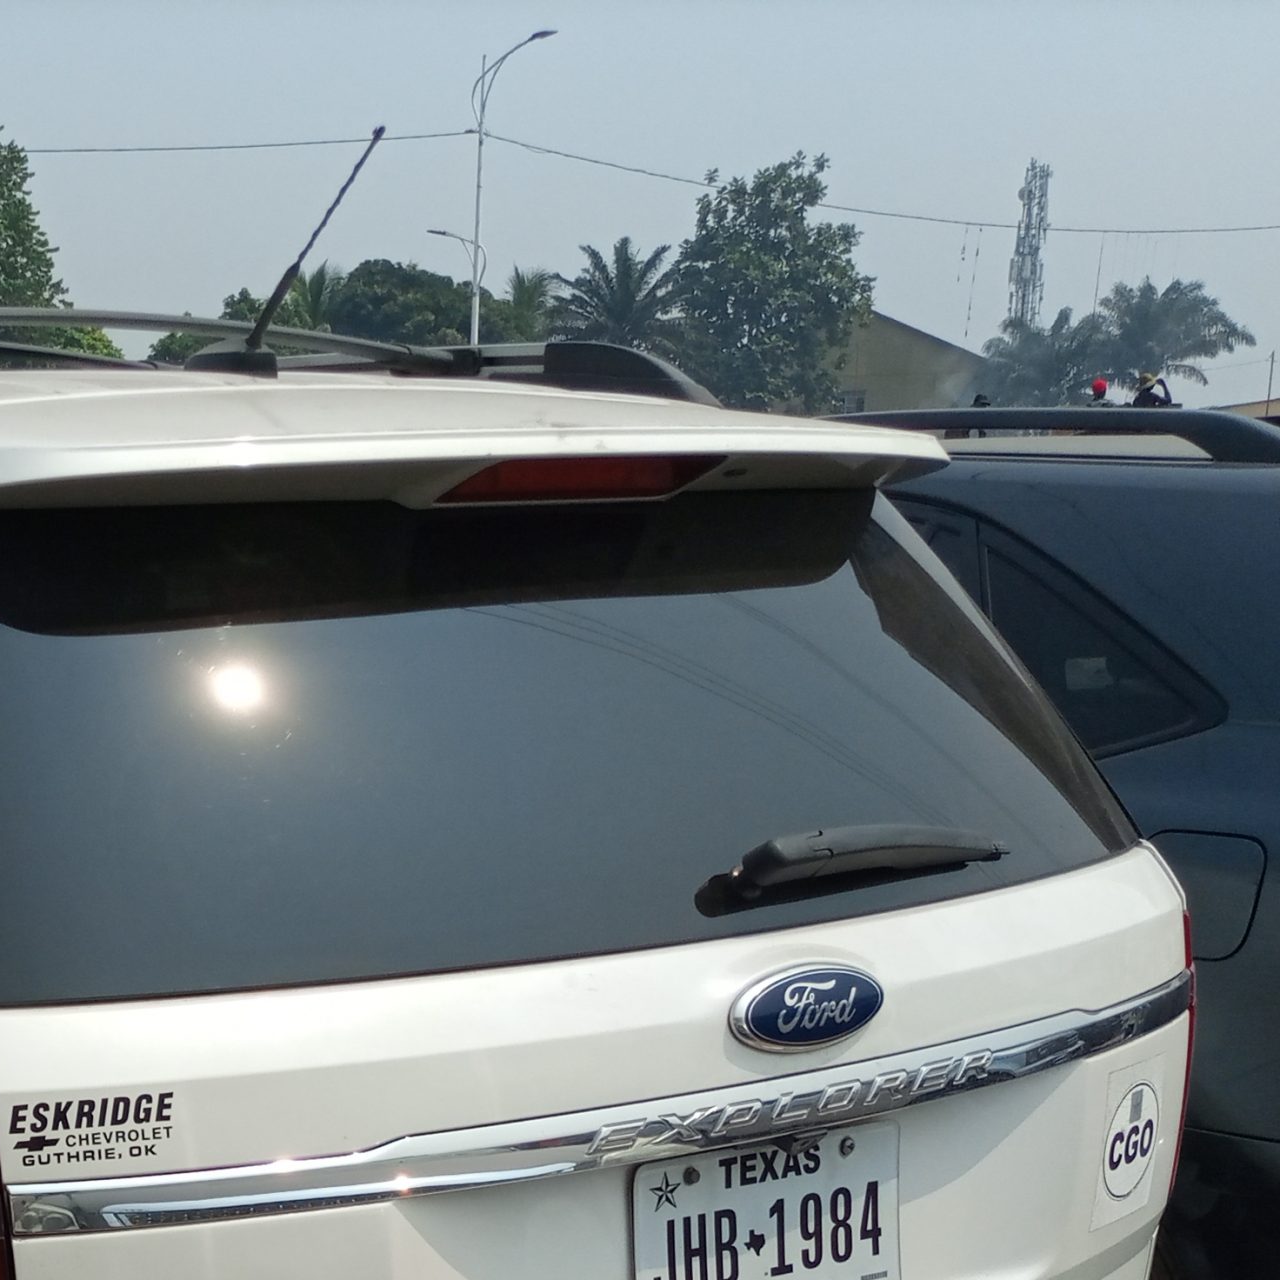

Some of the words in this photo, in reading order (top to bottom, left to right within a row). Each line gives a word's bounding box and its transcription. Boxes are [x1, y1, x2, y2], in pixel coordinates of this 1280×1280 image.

[777, 979, 857, 1035] Ford
[9, 1092, 174, 1135] ESKRIDGE
[585, 1048, 994, 1157] EXPLORER
[22, 1147, 122, 1167] GUTHRIE,
[129, 1144, 157, 1158] OK
[65, 1126, 173, 1147] CHEVROLET
[1108, 1118, 1154, 1171] CGO
[719, 1143, 821, 1190] TEXAS
[769, 1180, 882, 1277] 1984
